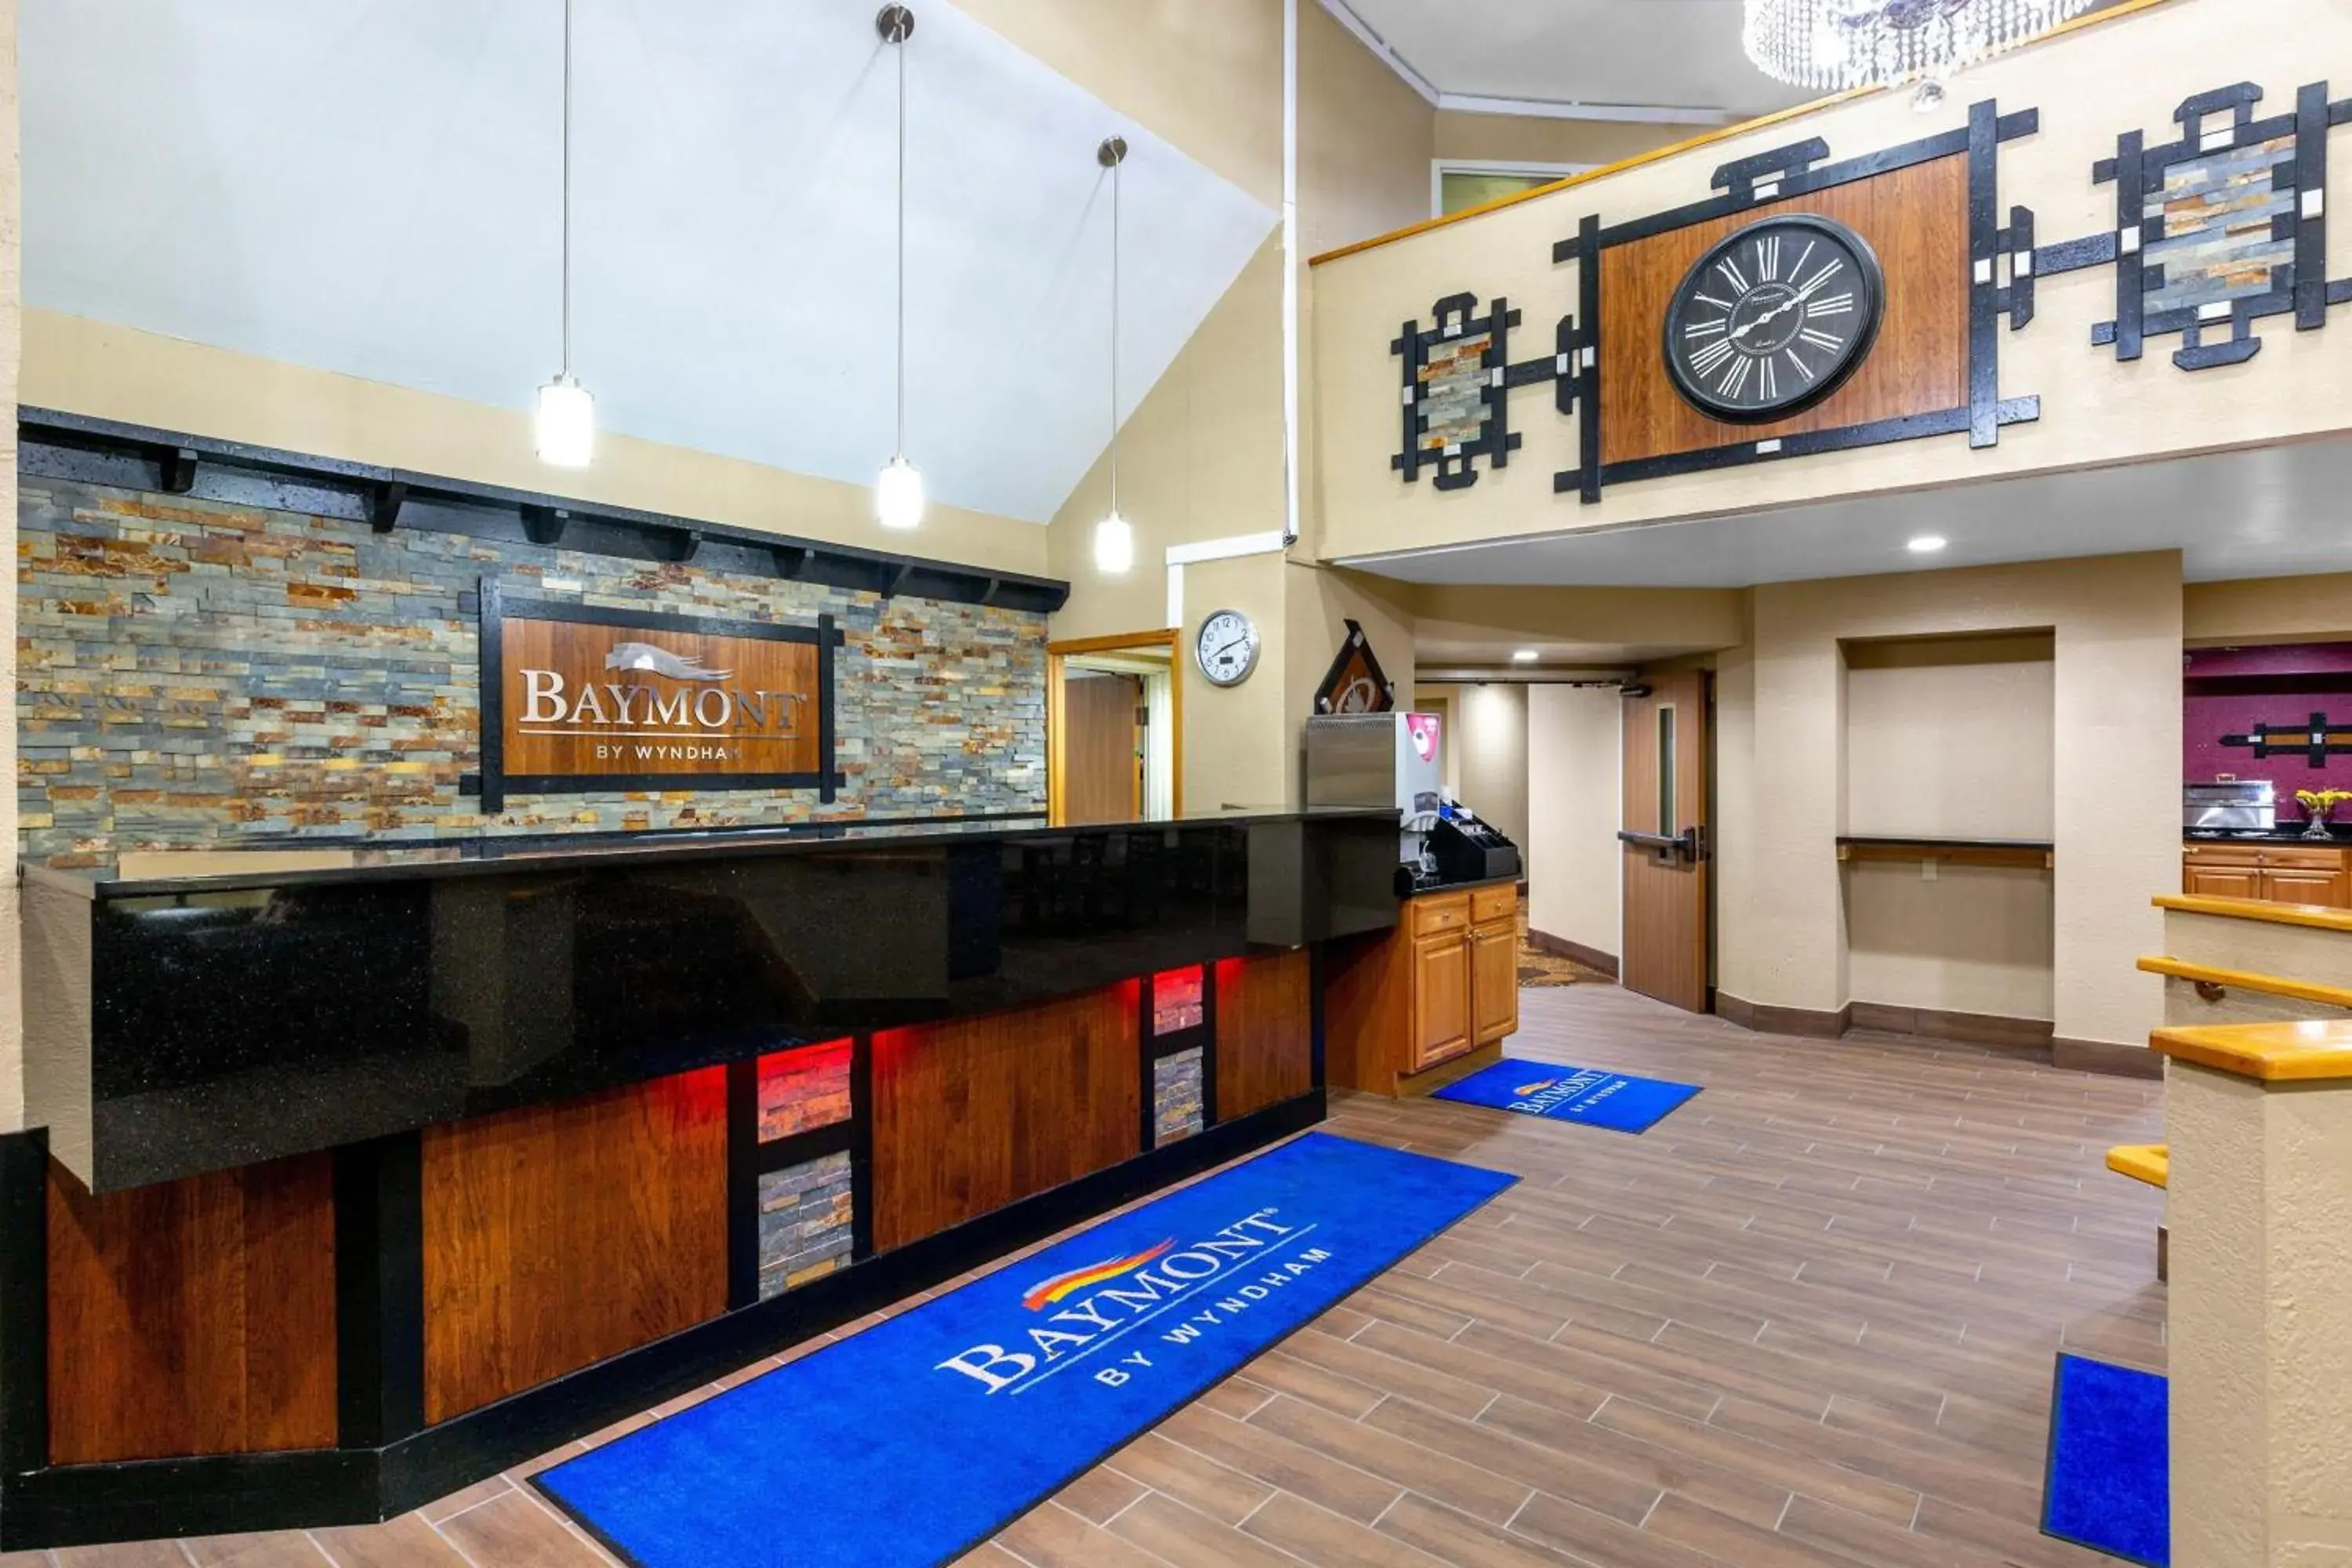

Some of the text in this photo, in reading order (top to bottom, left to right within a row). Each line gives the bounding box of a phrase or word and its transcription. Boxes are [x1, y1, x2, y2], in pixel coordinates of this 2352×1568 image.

[597, 746, 623, 760] BY
[1094, 1247, 1332, 1388] BY WYNDHAM
